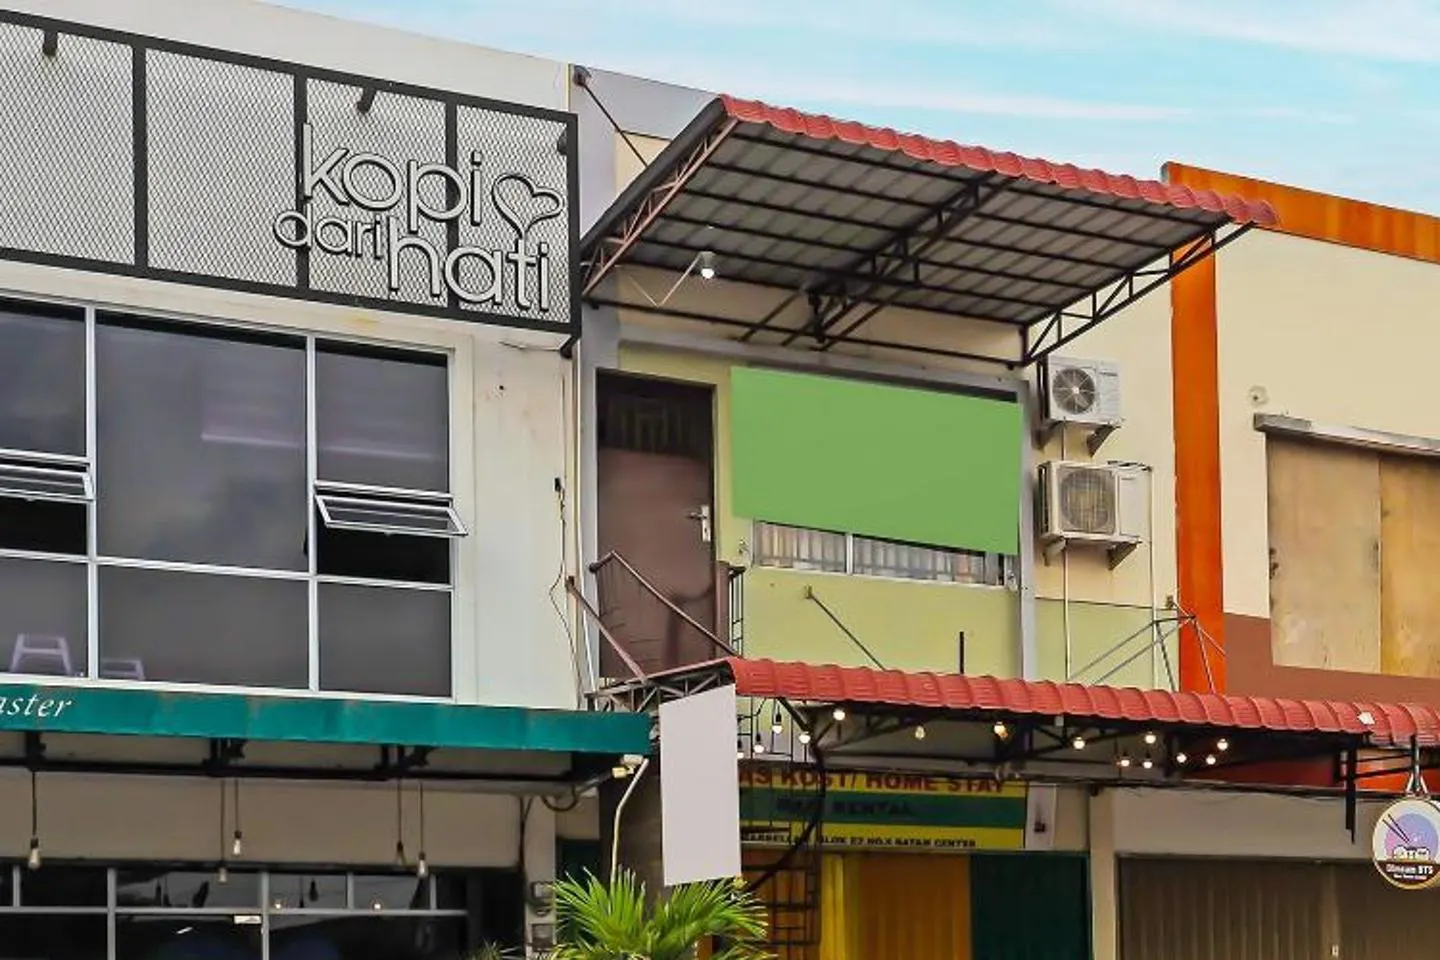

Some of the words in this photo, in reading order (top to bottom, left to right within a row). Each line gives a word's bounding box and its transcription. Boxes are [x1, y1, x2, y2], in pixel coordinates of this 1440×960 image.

[301, 122, 483, 228] kopi
[273, 202, 381, 260] dari
[387, 212, 550, 312] hati
[865, 773, 938, 792] HOME
[934, 839, 976, 848] CENTER
